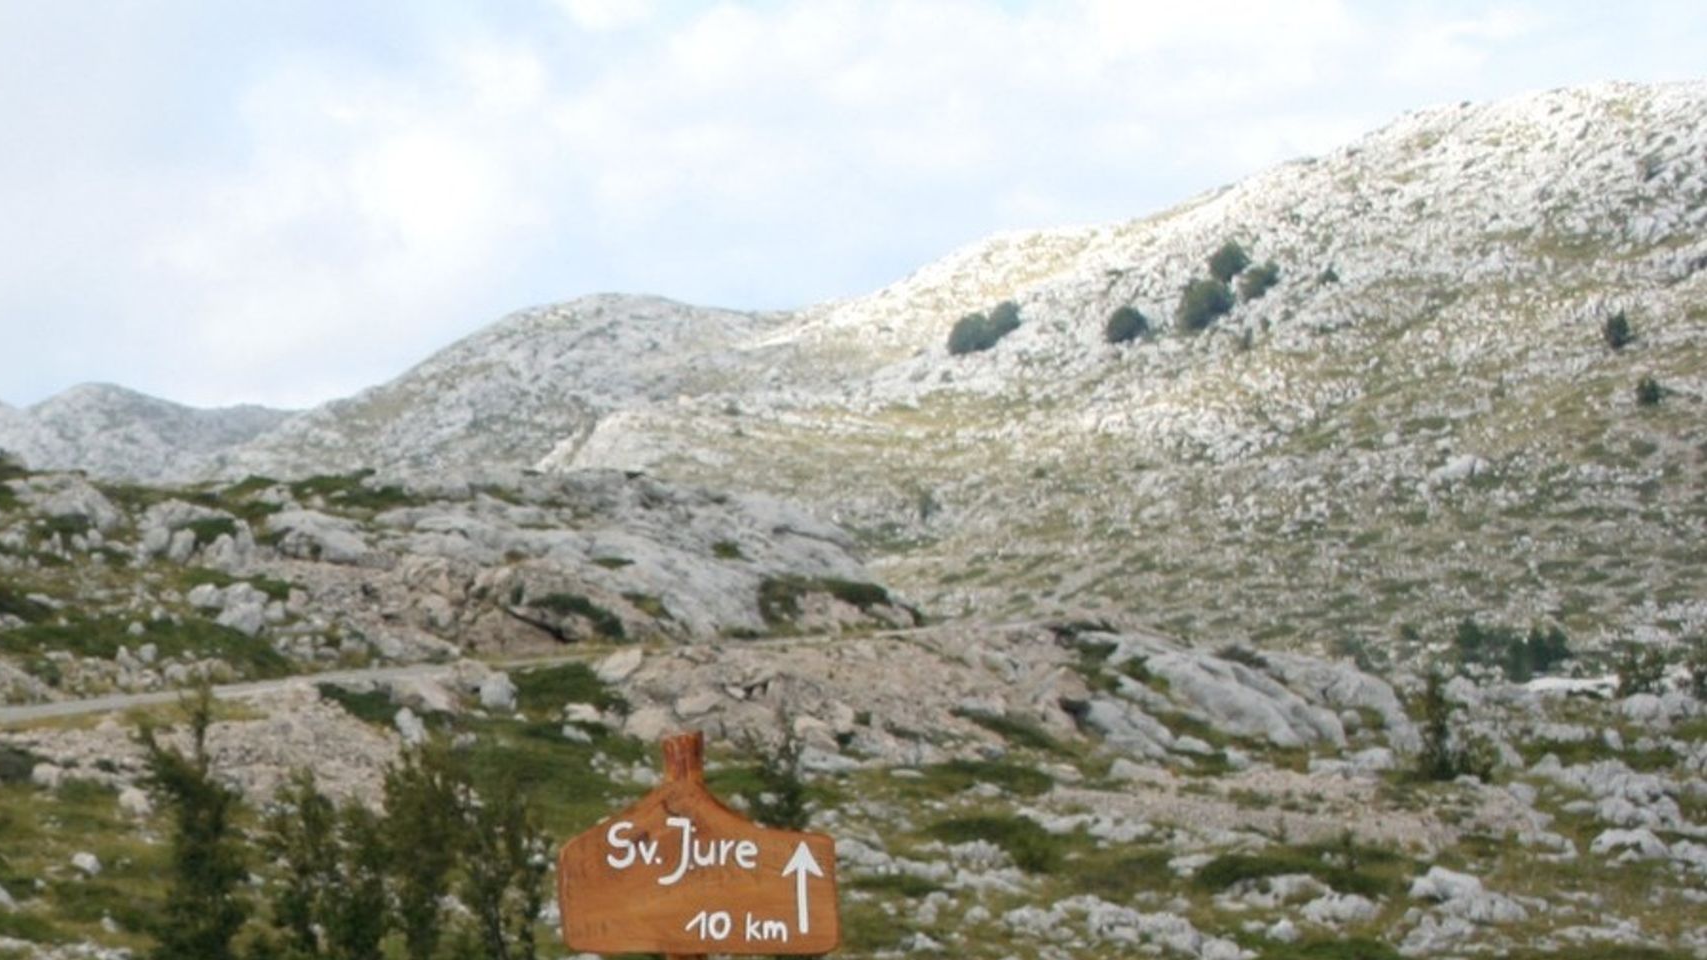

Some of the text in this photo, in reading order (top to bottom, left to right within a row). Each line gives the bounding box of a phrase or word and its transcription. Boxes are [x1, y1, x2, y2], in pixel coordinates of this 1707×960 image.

[606, 817, 759, 886] Sv. Jure
[685, 910, 788, 943] 10 km
